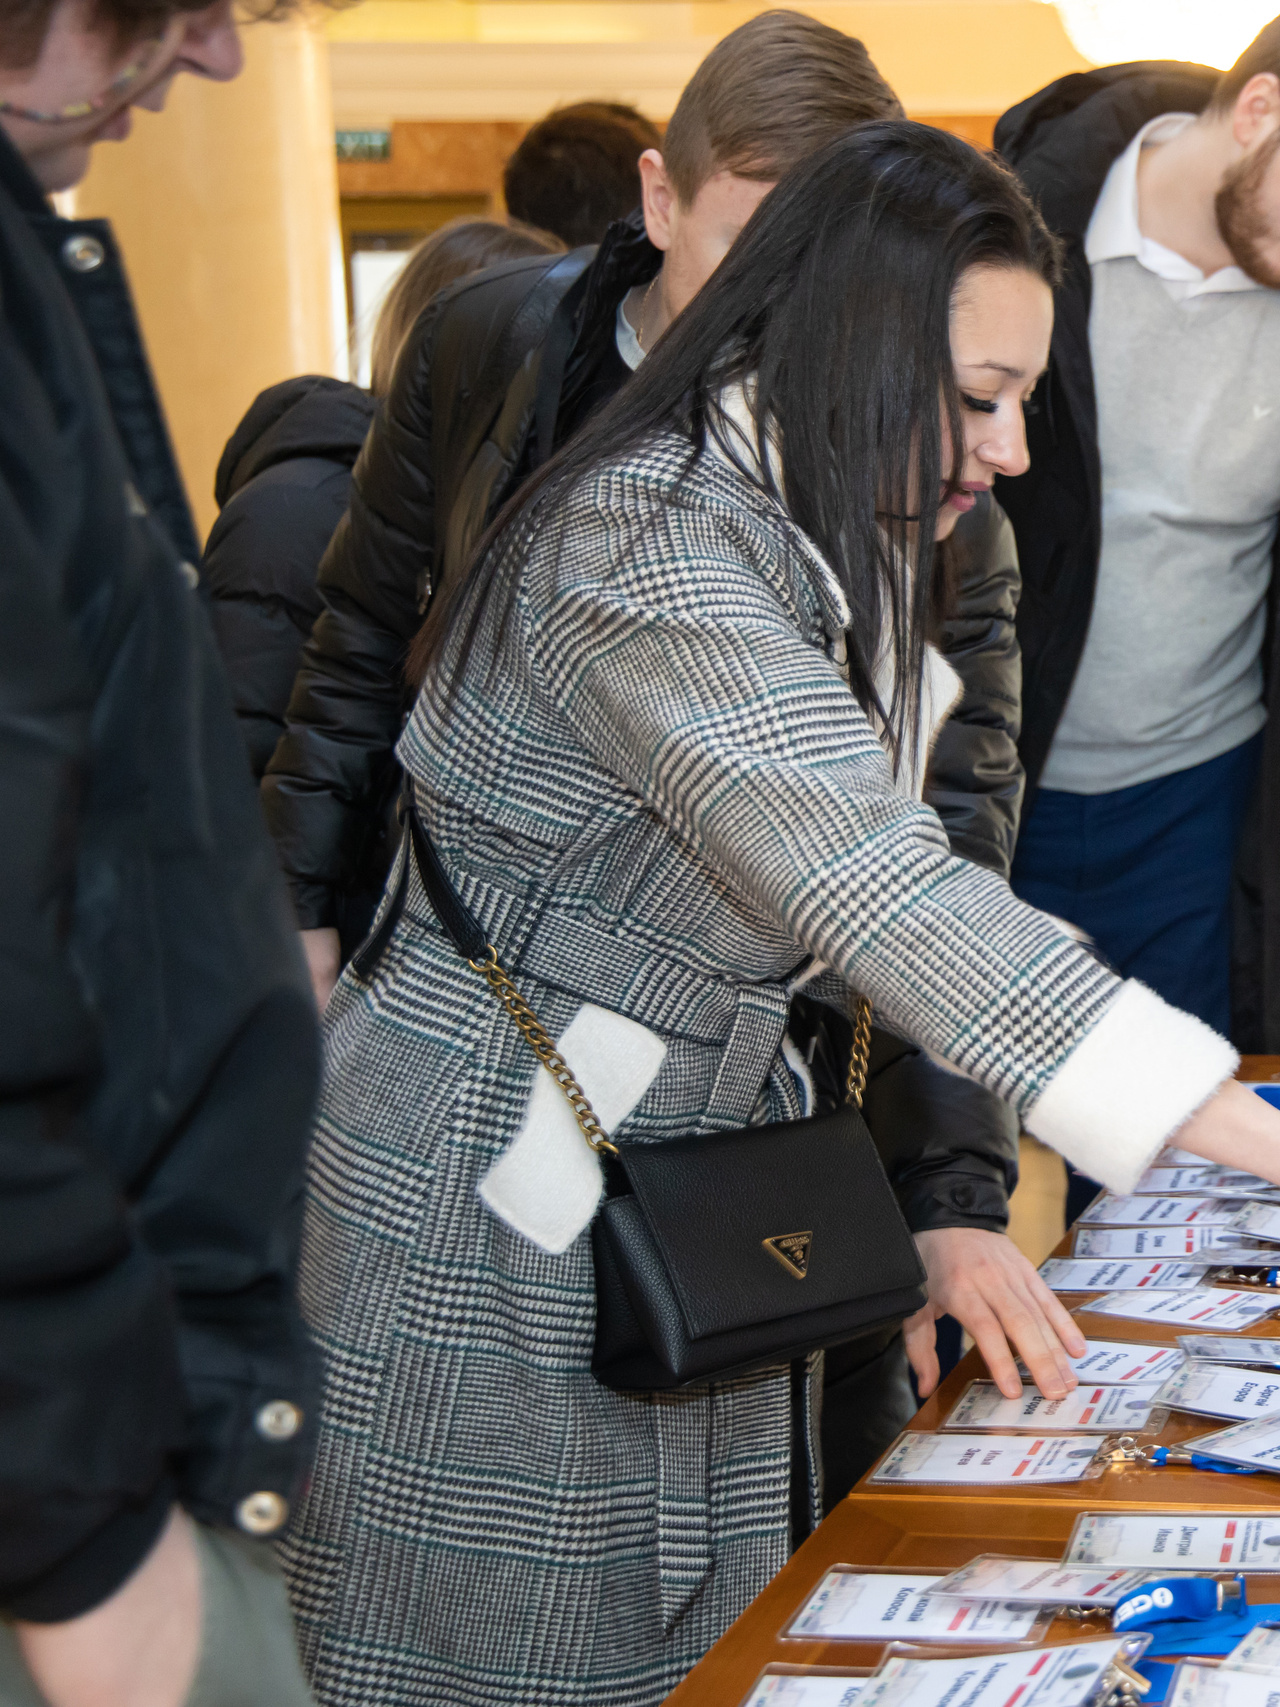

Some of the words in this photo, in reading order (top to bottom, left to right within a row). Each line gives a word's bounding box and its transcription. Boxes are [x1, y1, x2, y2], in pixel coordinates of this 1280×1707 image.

[1094, 1352, 1130, 1372] Сергей
[1232, 1381, 1261, 1404] Егоров
[1254, 1384, 1280, 1407] Сергей
[1023, 1394, 1047, 1415] Егоров
[956, 1447, 981, 1467] Зятев
[980, 1449, 1004, 1467] Илья
[1152, 1528, 1174, 1553] Иванов
[1176, 1525, 1199, 1557] Дмитрий
[906, 1596, 931, 1622] колай
